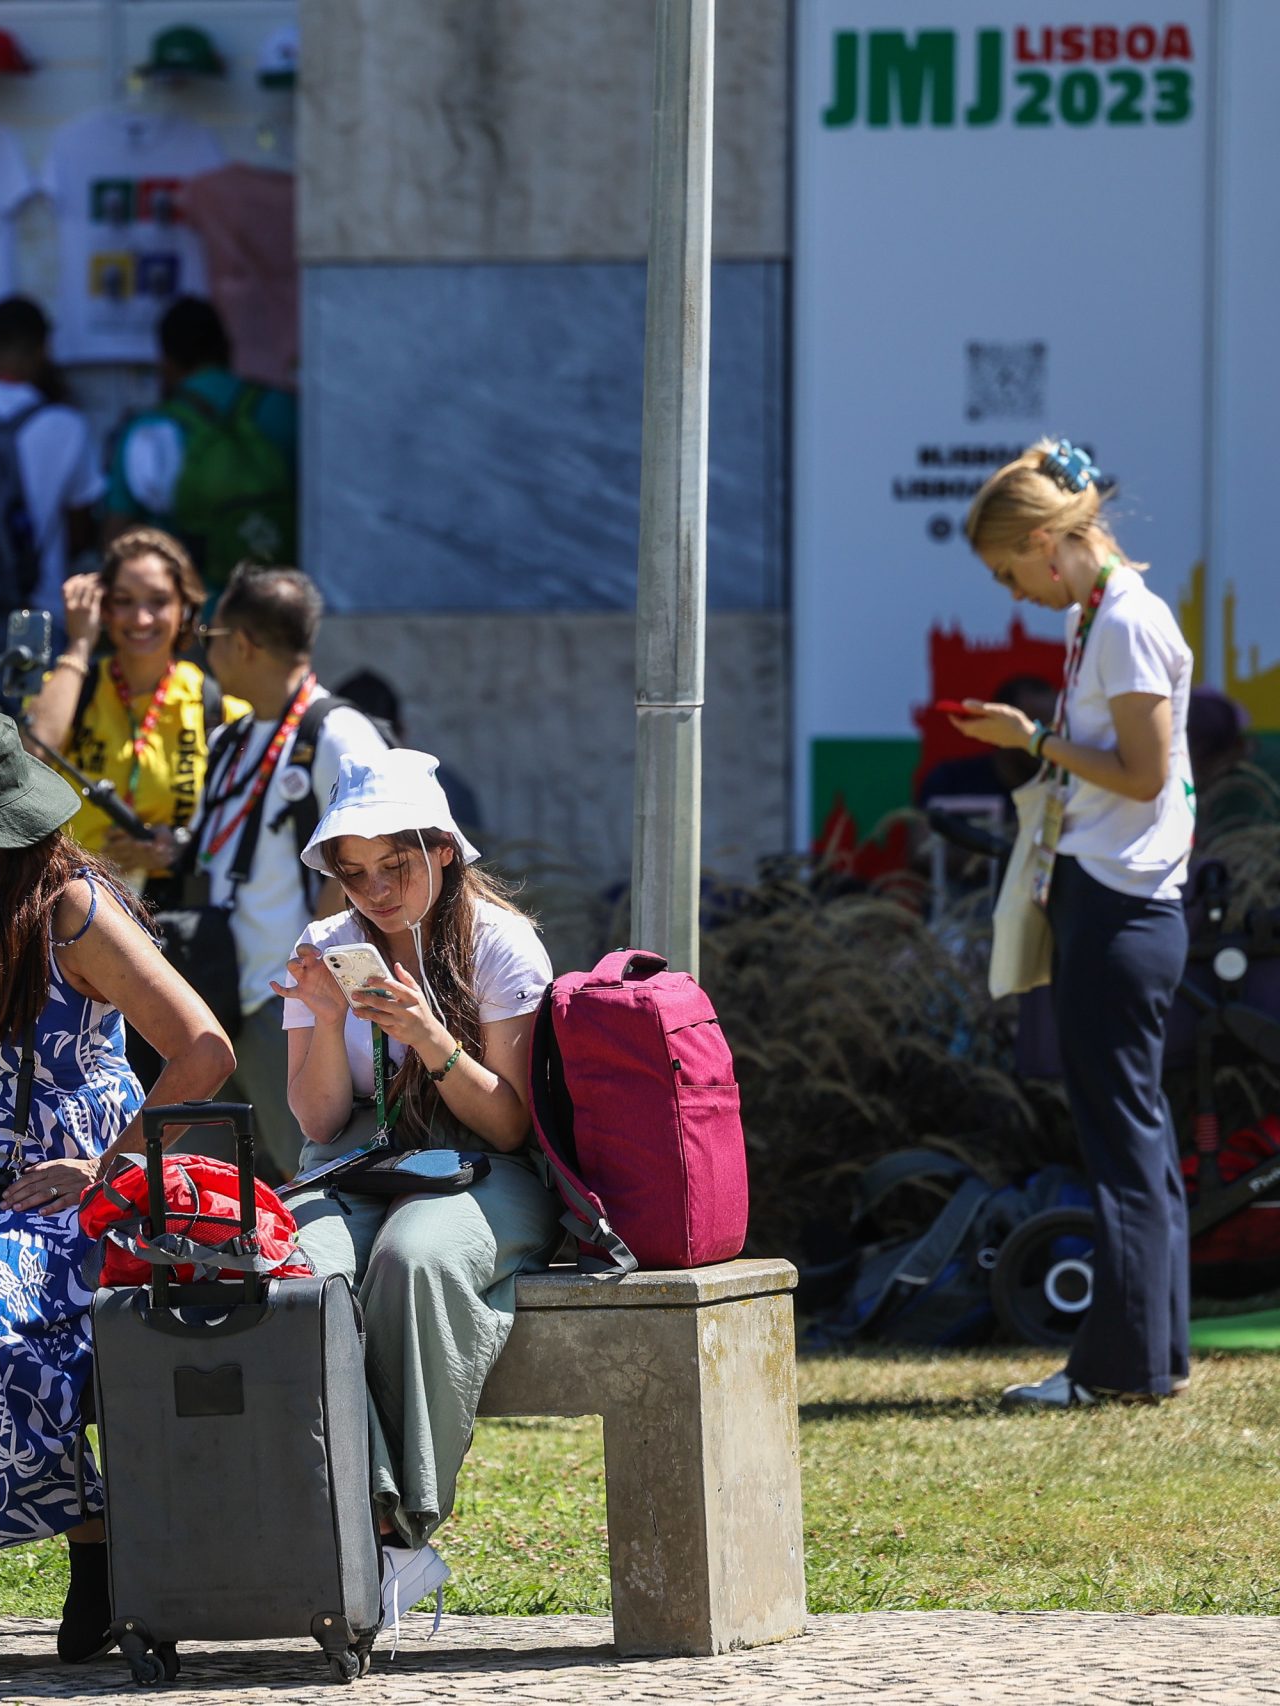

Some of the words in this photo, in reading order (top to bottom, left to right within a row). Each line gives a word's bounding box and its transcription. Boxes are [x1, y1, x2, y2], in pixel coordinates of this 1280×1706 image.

[1014, 25, 1194, 63] LISBOA
[823, 28, 1005, 127] JMJ
[1013, 70, 1195, 125] 2023
[374, 1047, 384, 1105] CASCAIS
